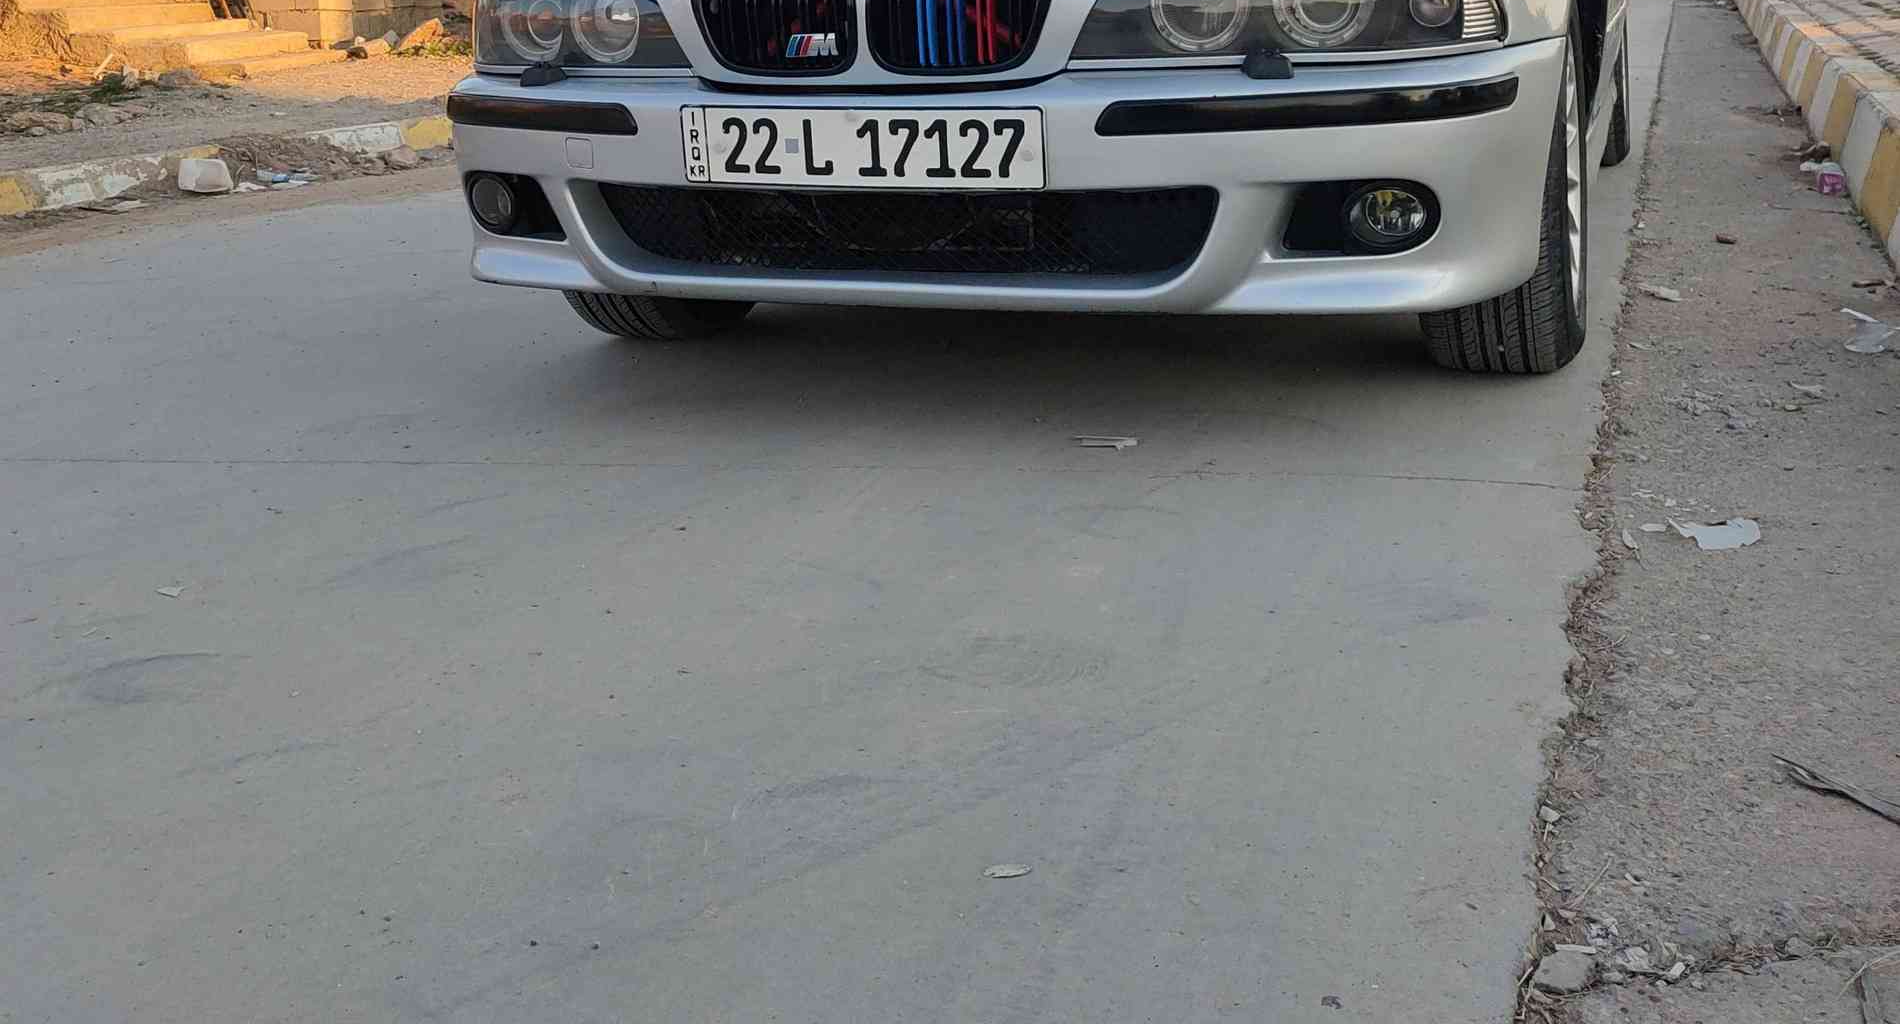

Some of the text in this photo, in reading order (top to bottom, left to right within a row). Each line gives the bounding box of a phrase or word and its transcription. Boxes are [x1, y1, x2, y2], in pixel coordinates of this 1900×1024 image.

[721, 117, 1026, 178] 22 L 17127
[689, 165, 706, 177] KR
